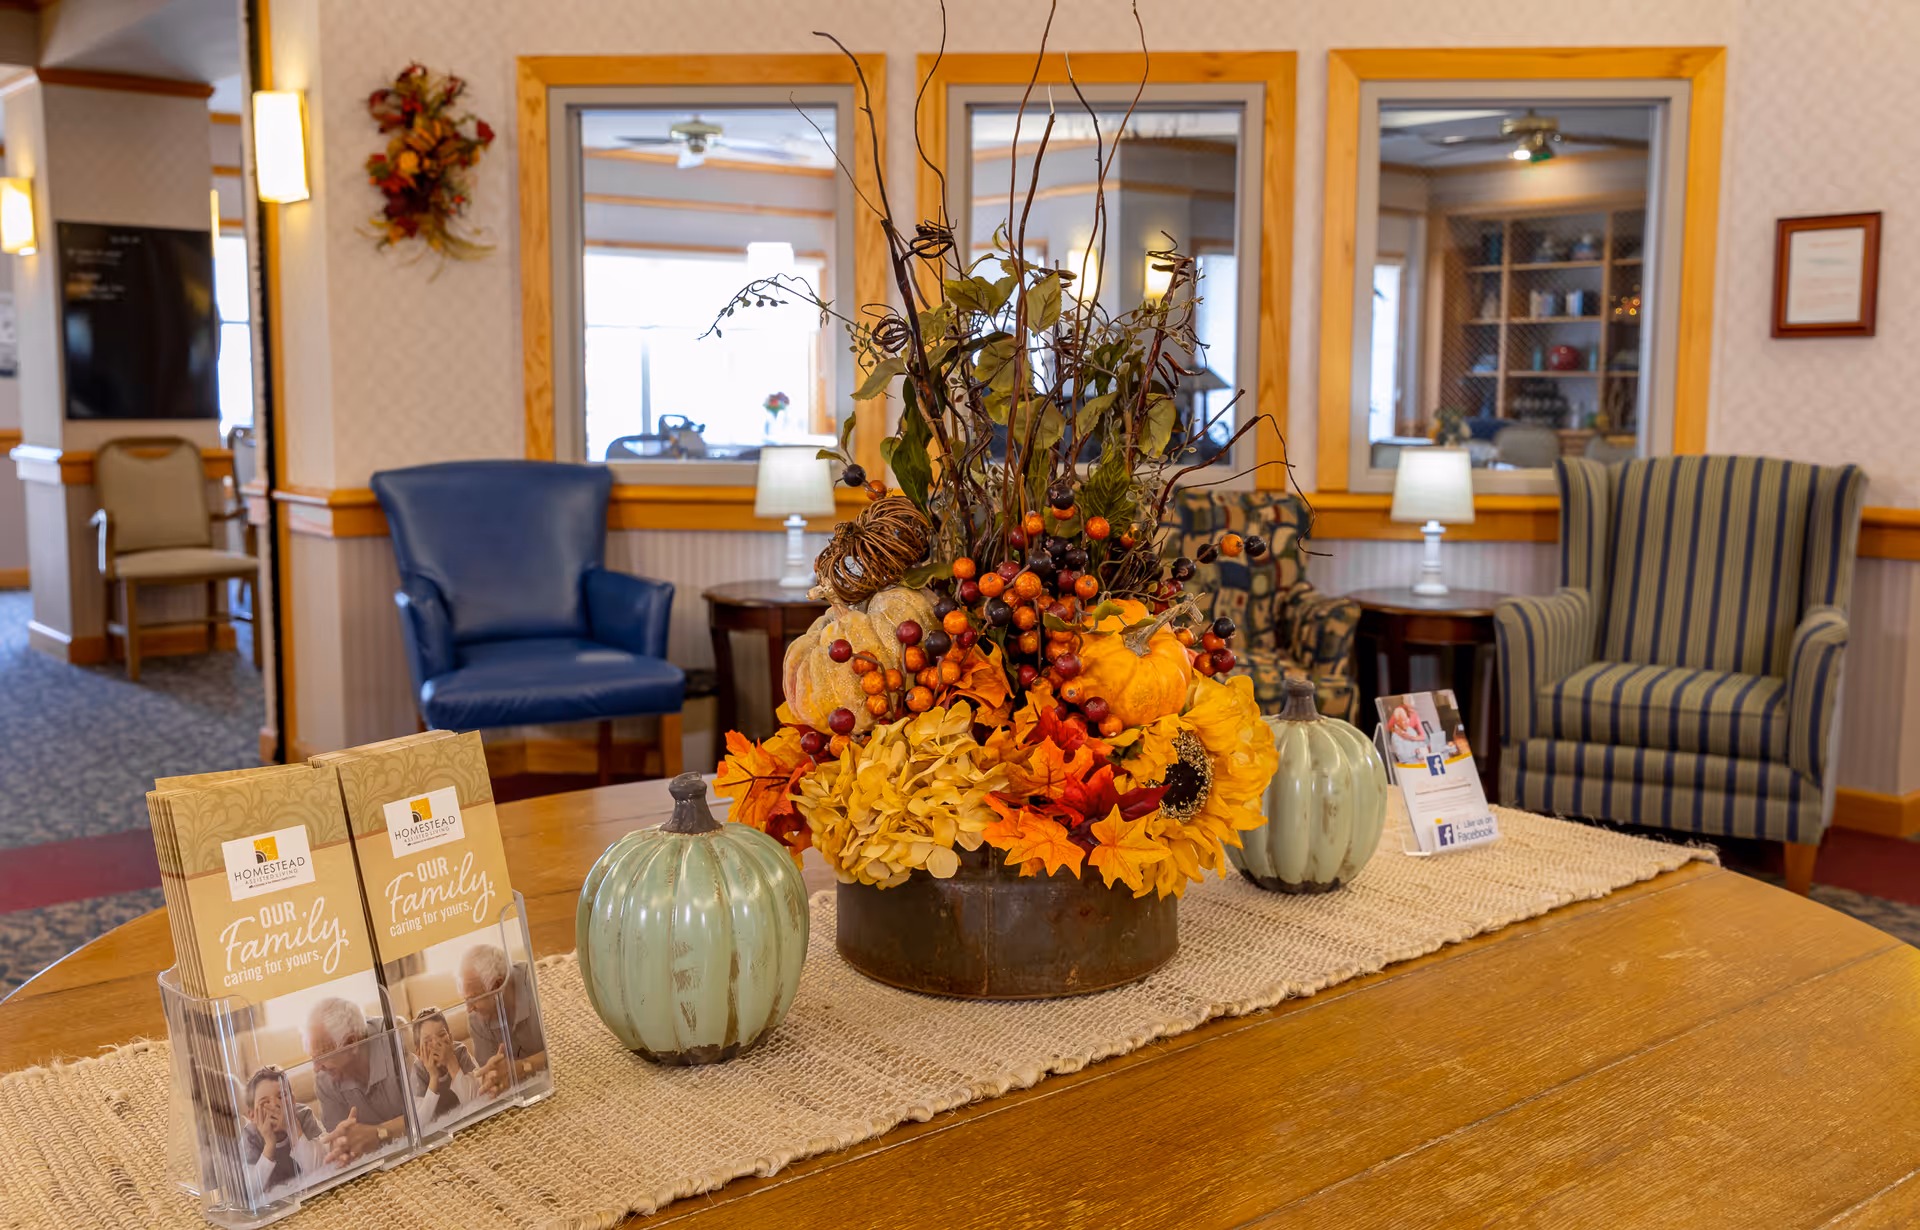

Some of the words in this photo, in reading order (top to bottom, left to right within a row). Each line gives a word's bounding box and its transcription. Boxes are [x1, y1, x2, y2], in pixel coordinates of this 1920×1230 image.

[394, 815, 456, 840] HOMESTEAD
[404, 831, 429, 843] ASSISTED
[430, 826, 450, 837] LIVING
[1457, 827, 1494, 841] Facebook
[234, 856, 305, 881] HOMESTEAD
[245, 874, 275, 885] ASSISTED
[275, 868, 298, 878] LIVING
[417, 857, 449, 882] OUR
[385, 852, 495, 923] Family,
[259, 901, 297, 928] OUR
[390, 917, 422, 937] caring
[423, 911, 438, 925] for
[440, 901, 473, 921] yours.
[219, 896, 350, 975] Family,
[223, 965, 264, 987] caring
[265, 959, 282, 975] for
[286, 949, 323, 972] yours.
